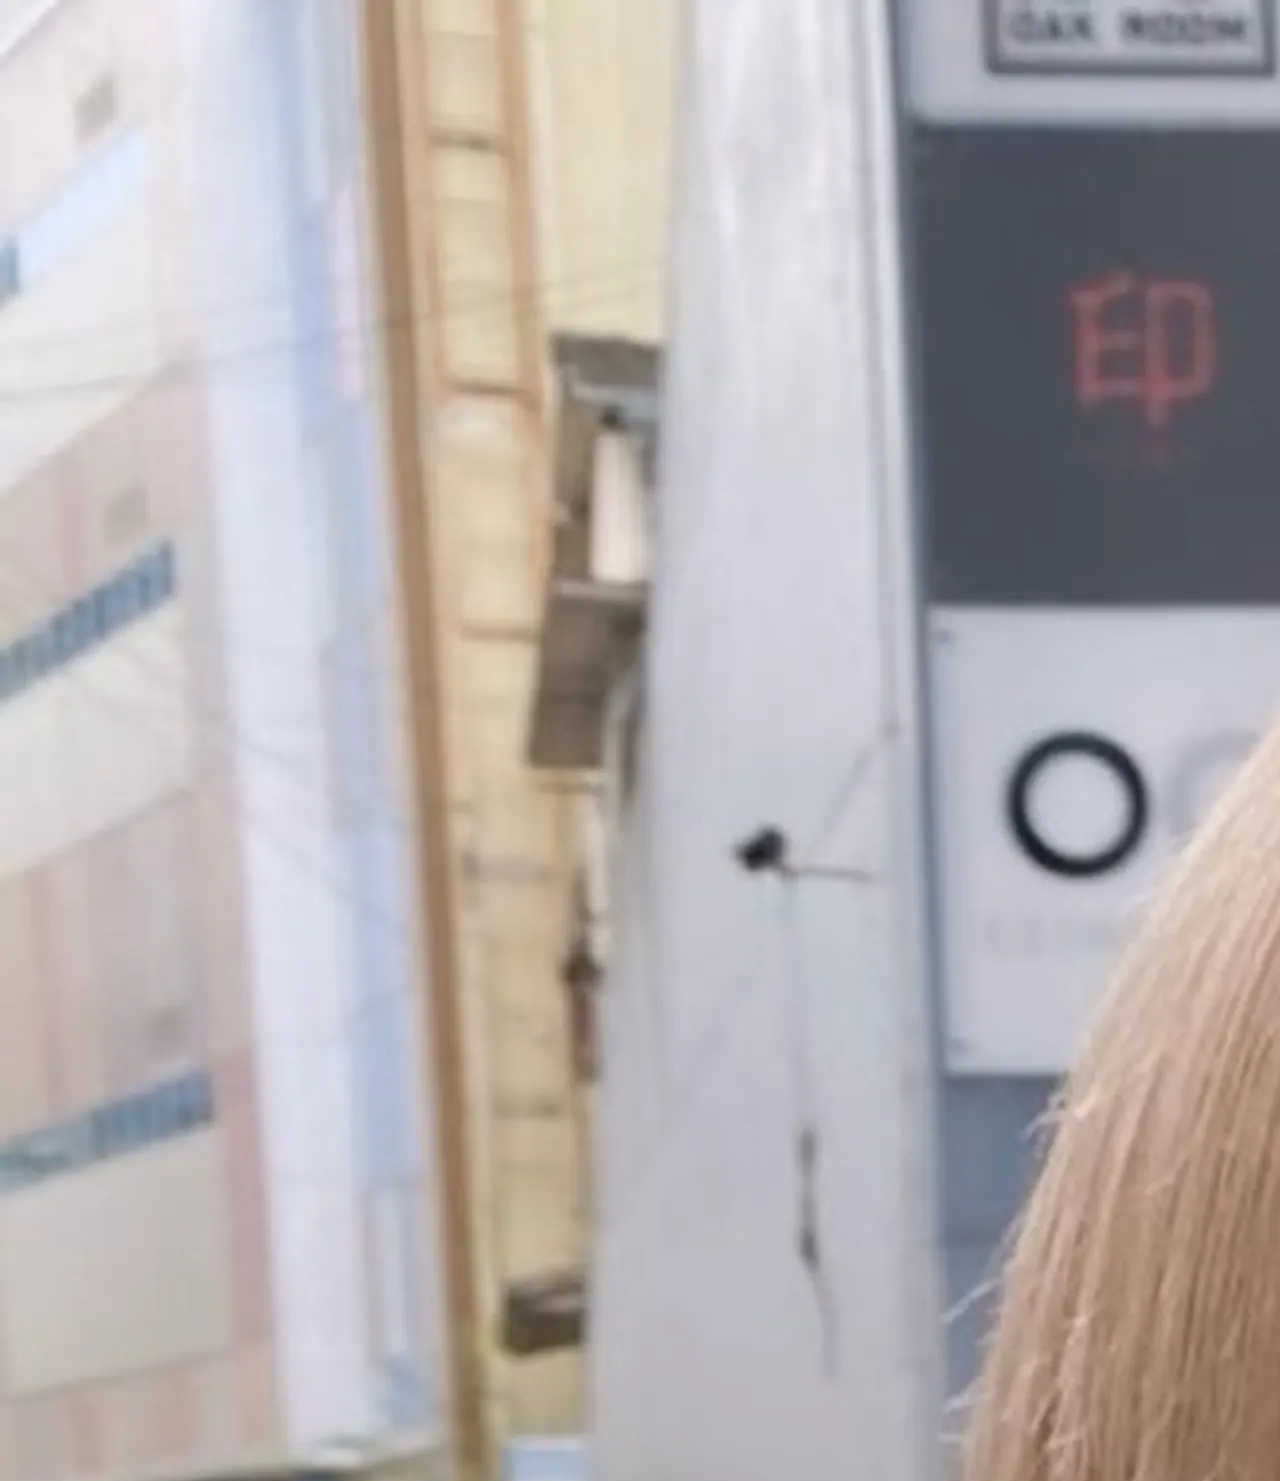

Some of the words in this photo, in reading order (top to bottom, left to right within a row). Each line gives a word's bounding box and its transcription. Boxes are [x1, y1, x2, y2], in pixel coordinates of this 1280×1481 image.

[1008, 9, 1096, 43] OAK
[1118, 9, 1247, 43] ROOM
[1066, 266, 1216, 428] 印
